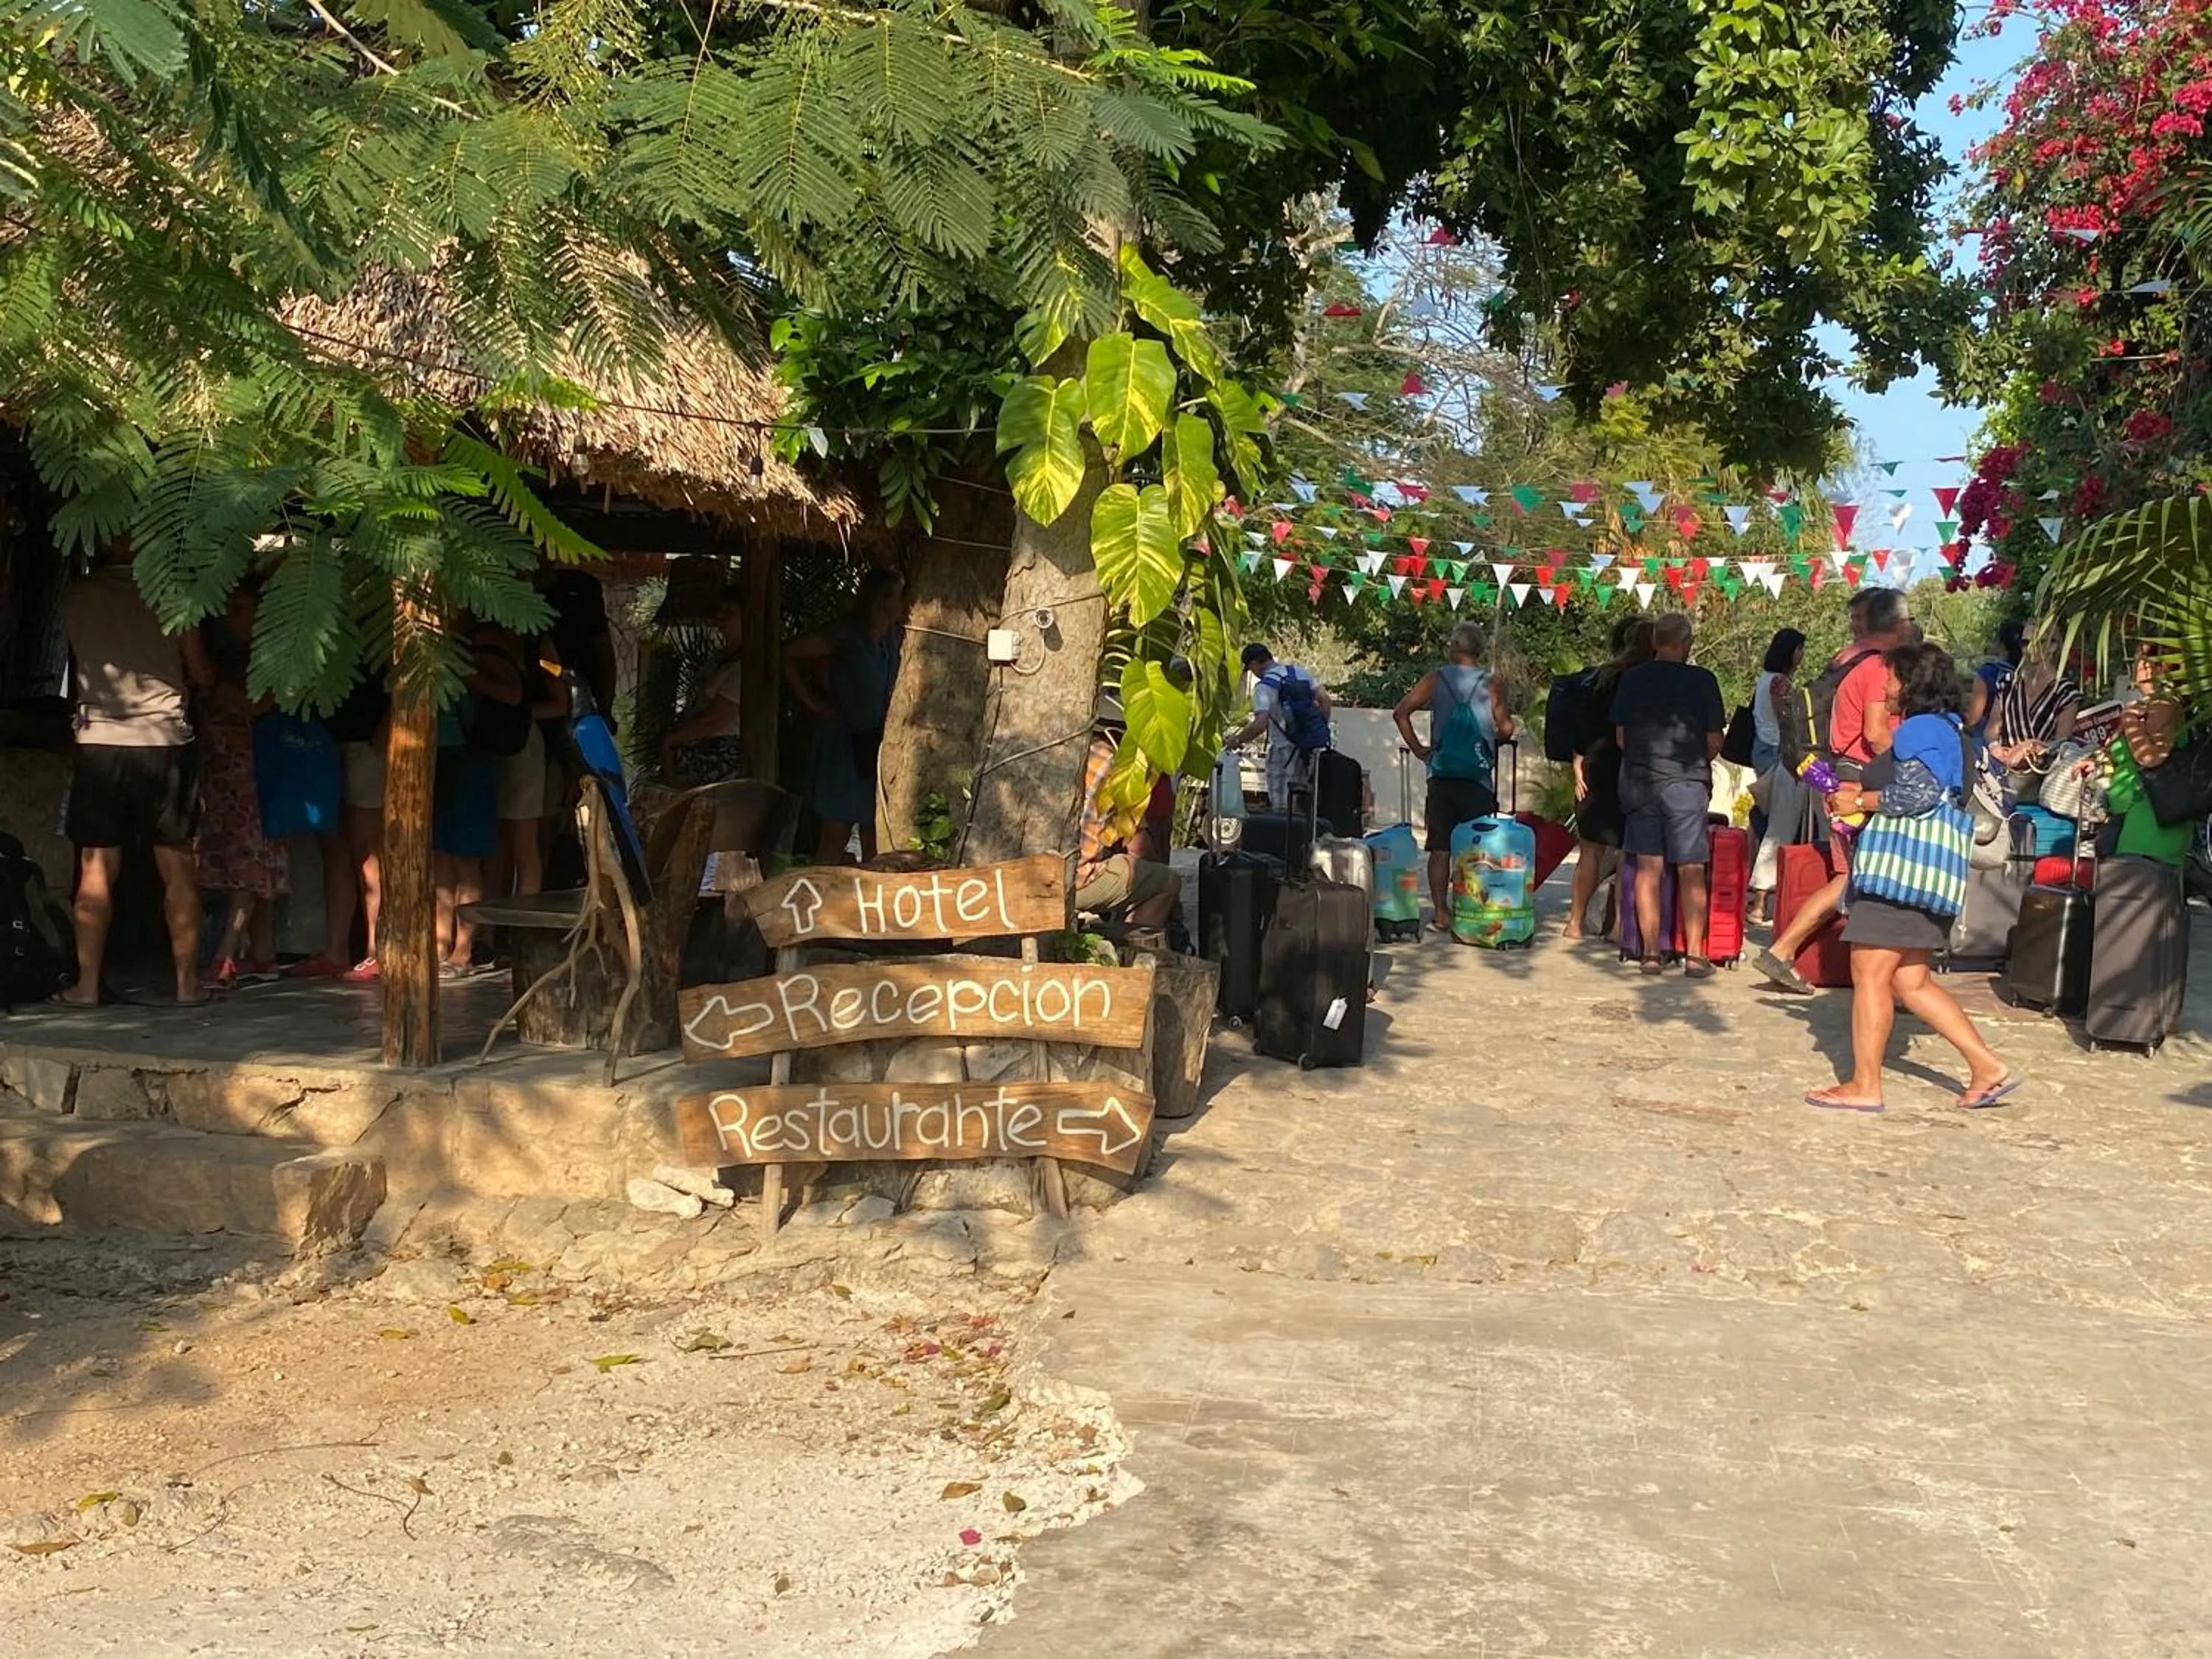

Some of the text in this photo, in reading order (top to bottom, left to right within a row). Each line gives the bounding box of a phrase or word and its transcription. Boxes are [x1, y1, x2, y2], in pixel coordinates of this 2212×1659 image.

[855, 869, 1015, 934] Hotel
[776, 966, 1111, 1041] Recepcion
[709, 1086, 1047, 1158] Restaurante
